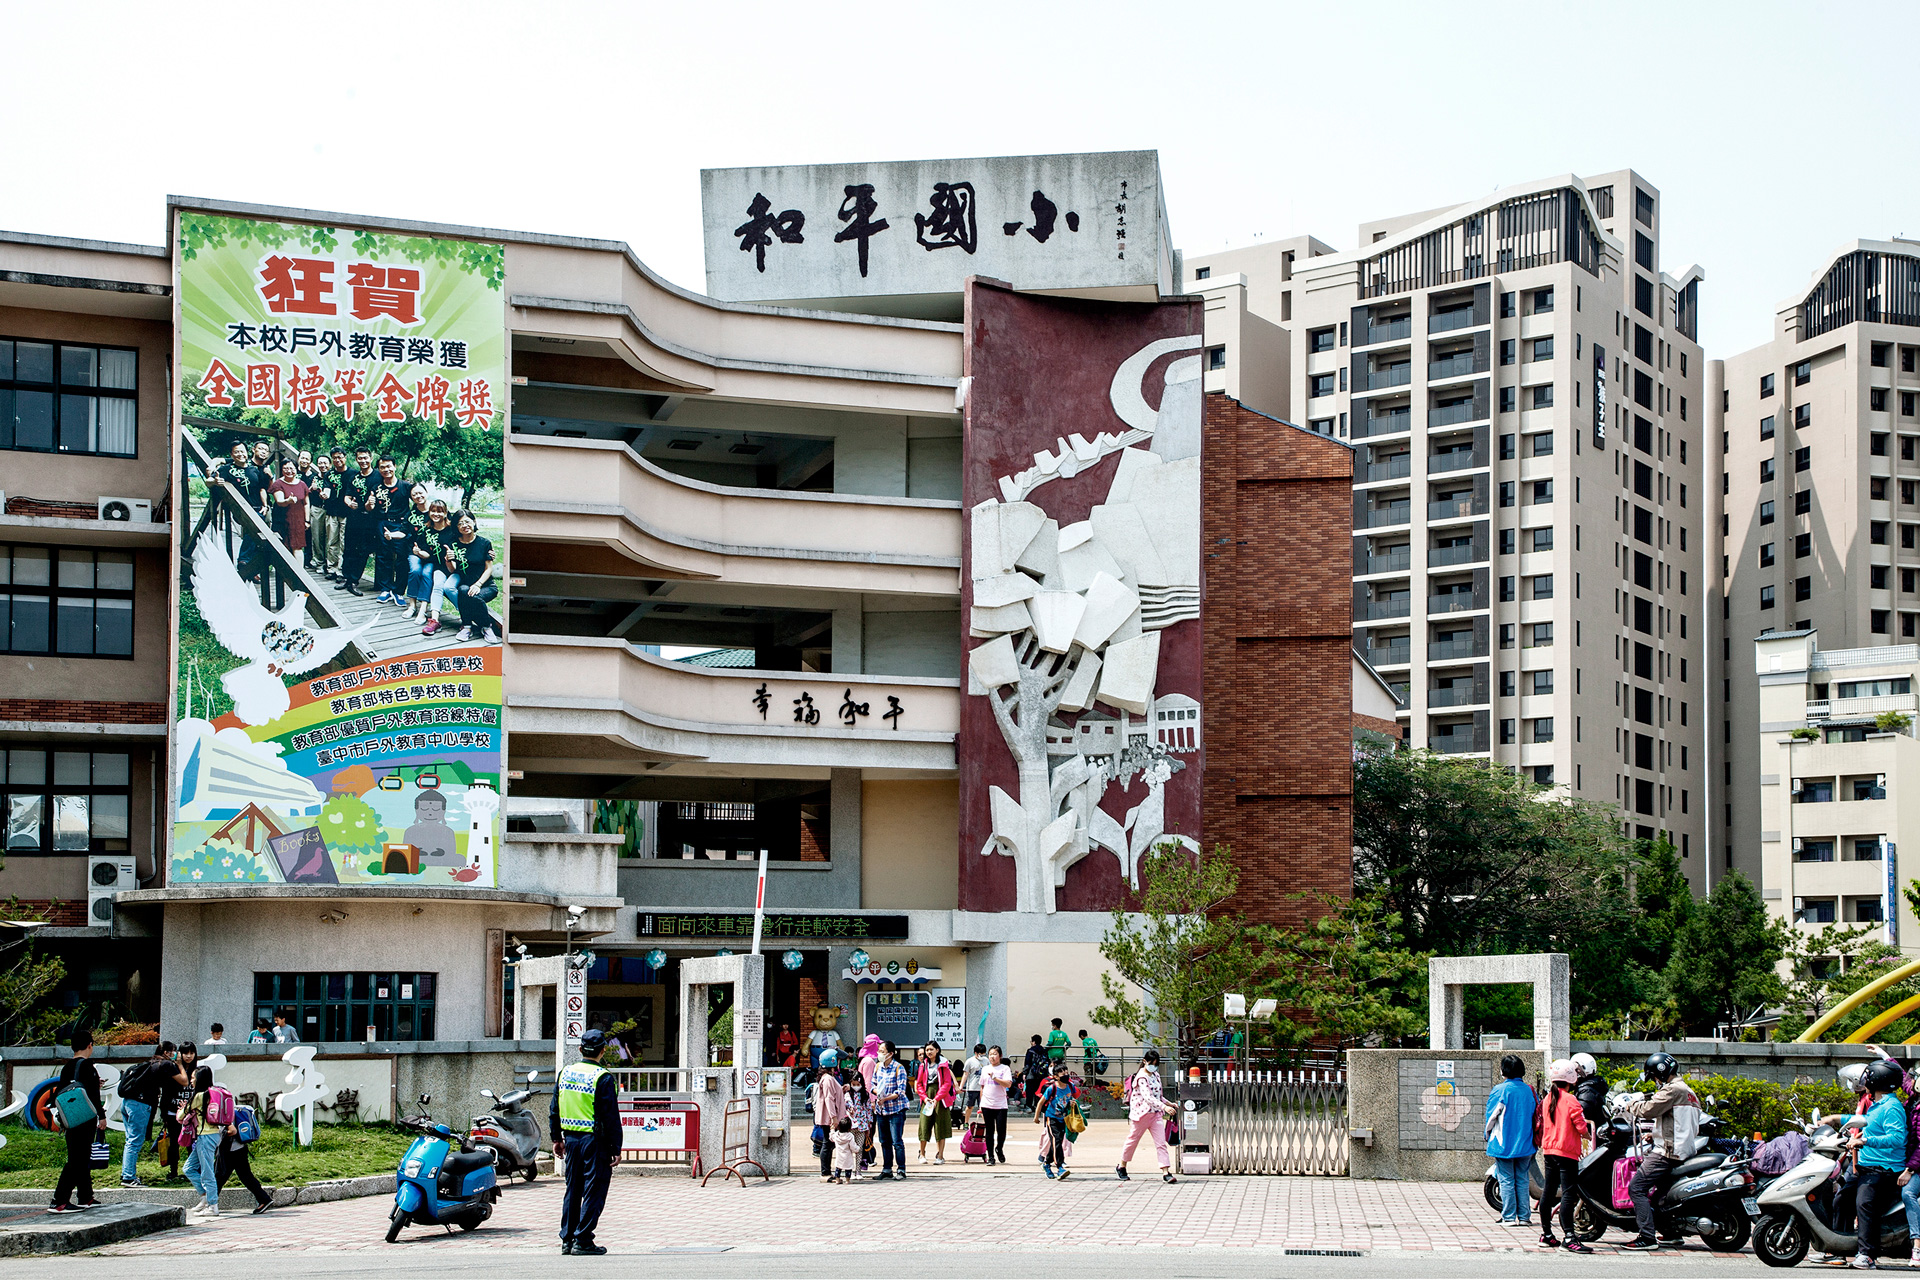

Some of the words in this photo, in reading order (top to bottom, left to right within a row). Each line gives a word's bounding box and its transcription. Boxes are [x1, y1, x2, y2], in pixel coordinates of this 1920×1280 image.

[733, 182, 1080, 278] 和平國小
[260, 254, 420, 323] 狂賀
[227, 322, 467, 369] 本校戶外教育榮獲
[199, 359, 494, 430] 全國標竿金牌獎
[310, 655, 483, 697] 教育部戶外教育示範學校
[330, 682, 473, 715] 教育部特色學校特優
[752, 683, 904, 730] 幸福和平
[292, 707, 497, 751] 教育部優質戶外教育路線特優
[317, 731, 490, 766] 臺中市戶外教育中心學校
[935, 1010, 961, 1018] Her-Ping
[936, 995, 960, 1009] 和平
